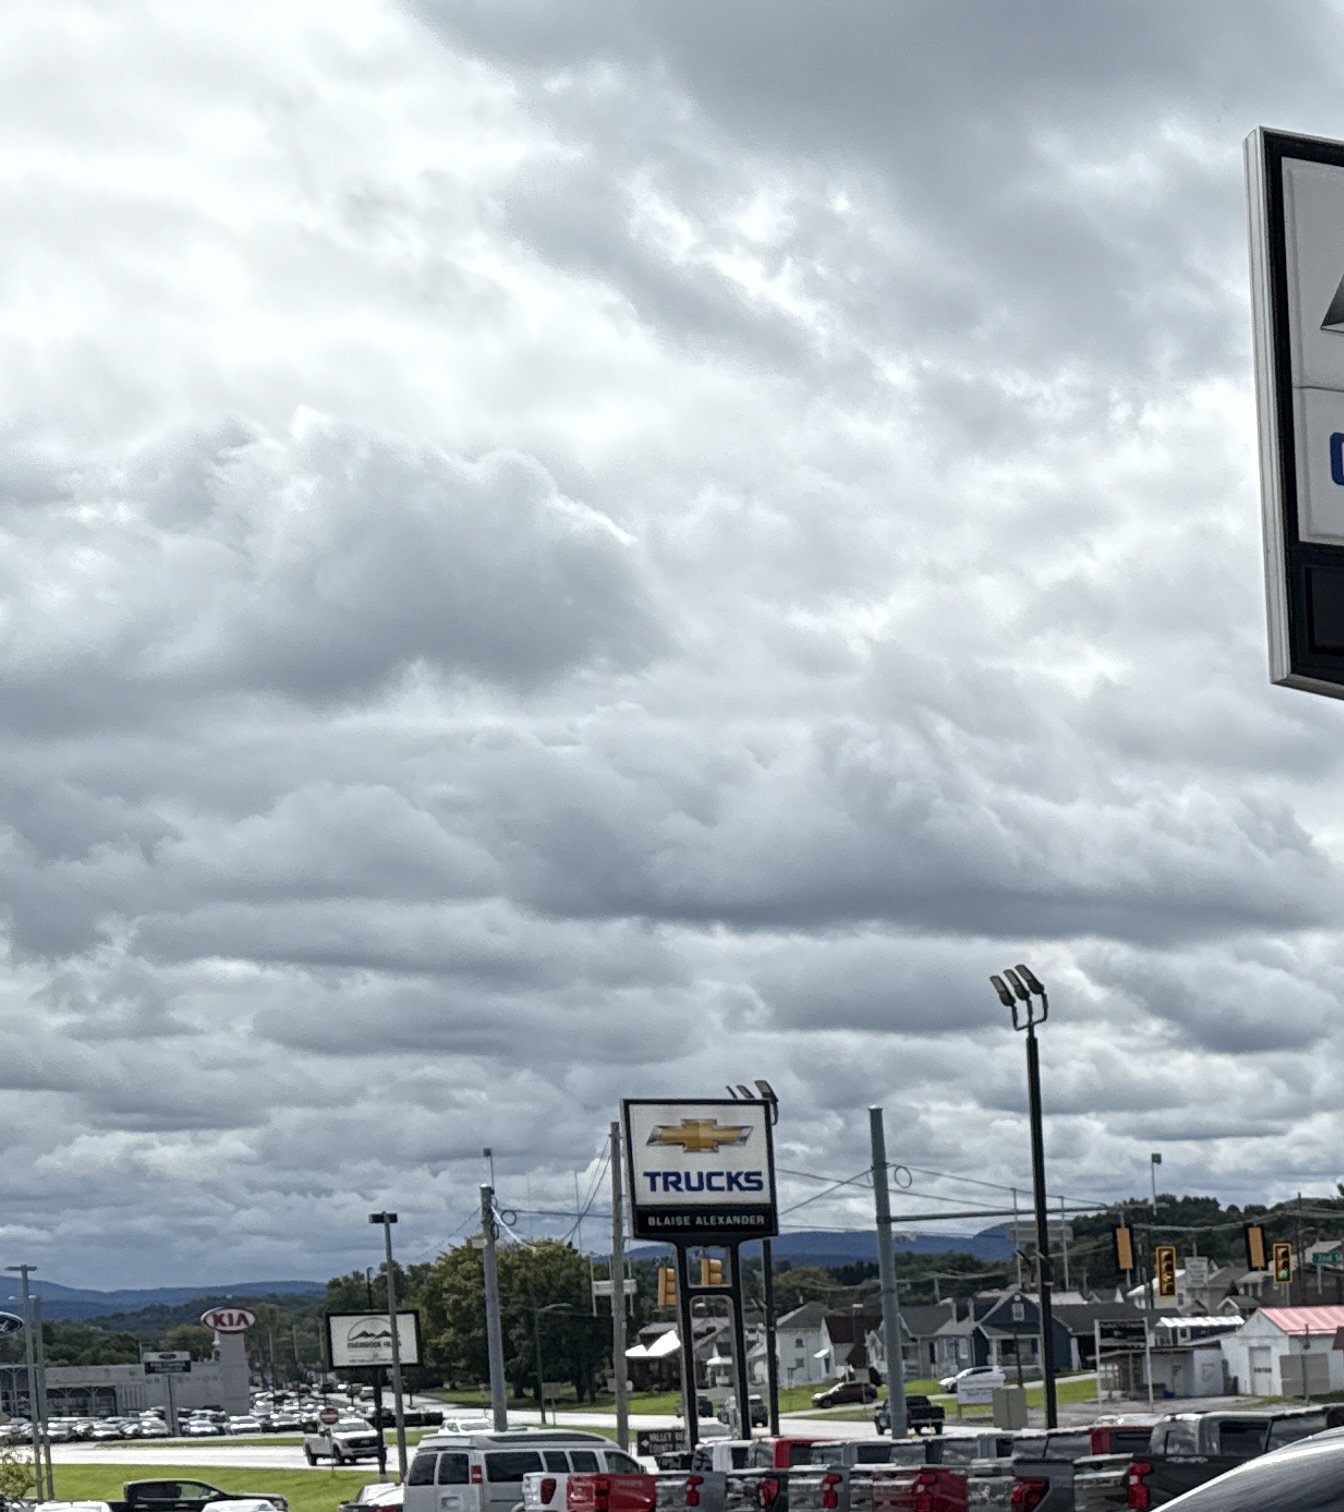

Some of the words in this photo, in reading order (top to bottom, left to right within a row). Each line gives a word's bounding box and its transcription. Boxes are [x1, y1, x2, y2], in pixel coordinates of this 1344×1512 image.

[643, 1170, 764, 1192] TRUCKS
[648, 1215, 691, 1226] BLAISE
[695, 1215, 765, 1226] ALEXANDER
[212, 1312, 251, 1328] KIA
